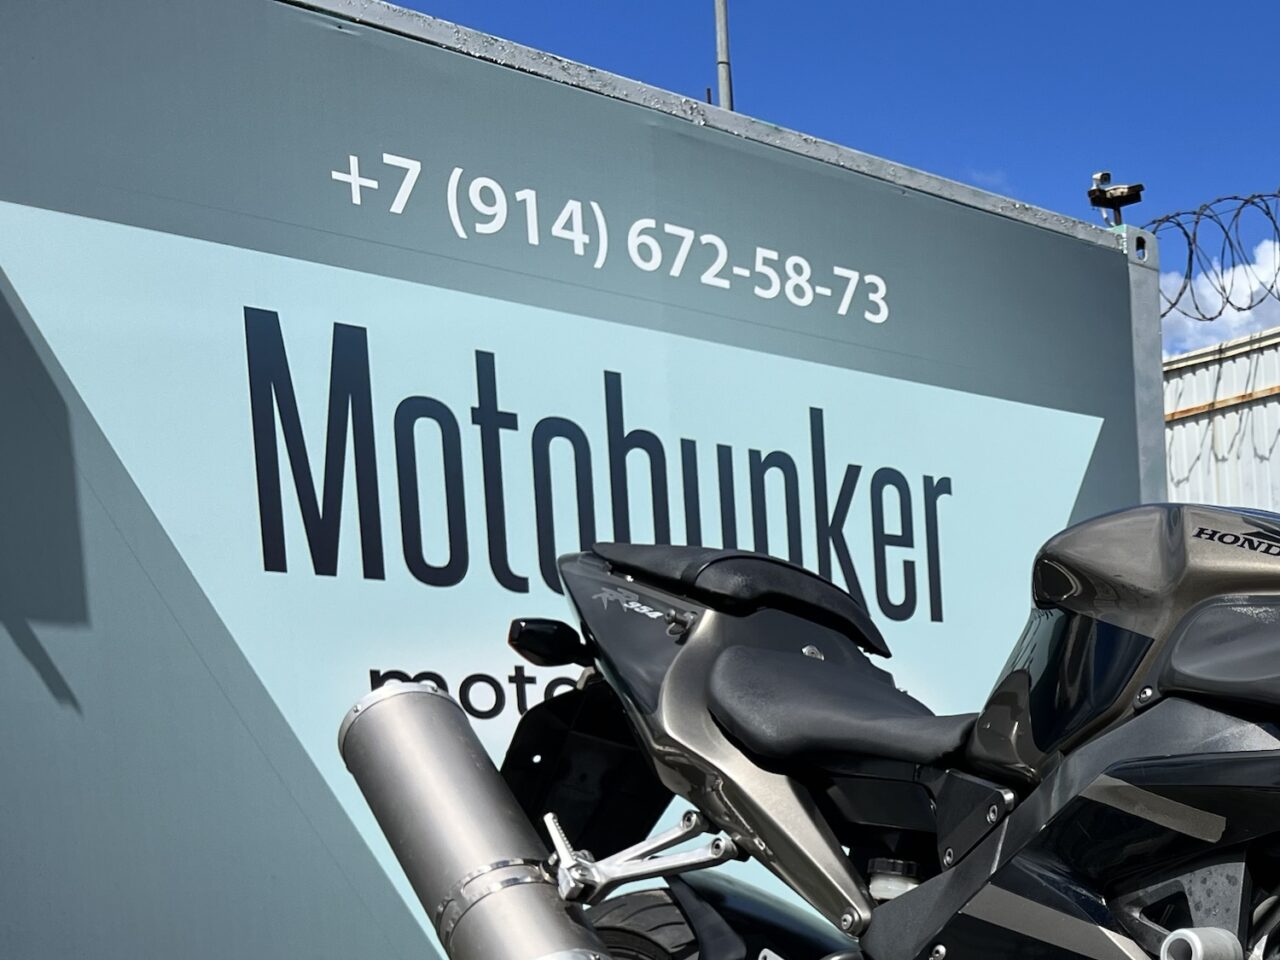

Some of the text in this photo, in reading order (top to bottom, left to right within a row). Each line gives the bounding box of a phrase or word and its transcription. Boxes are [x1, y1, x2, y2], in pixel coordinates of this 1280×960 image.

[331, 152, 890, 324] +7 (914) 672-58-73
